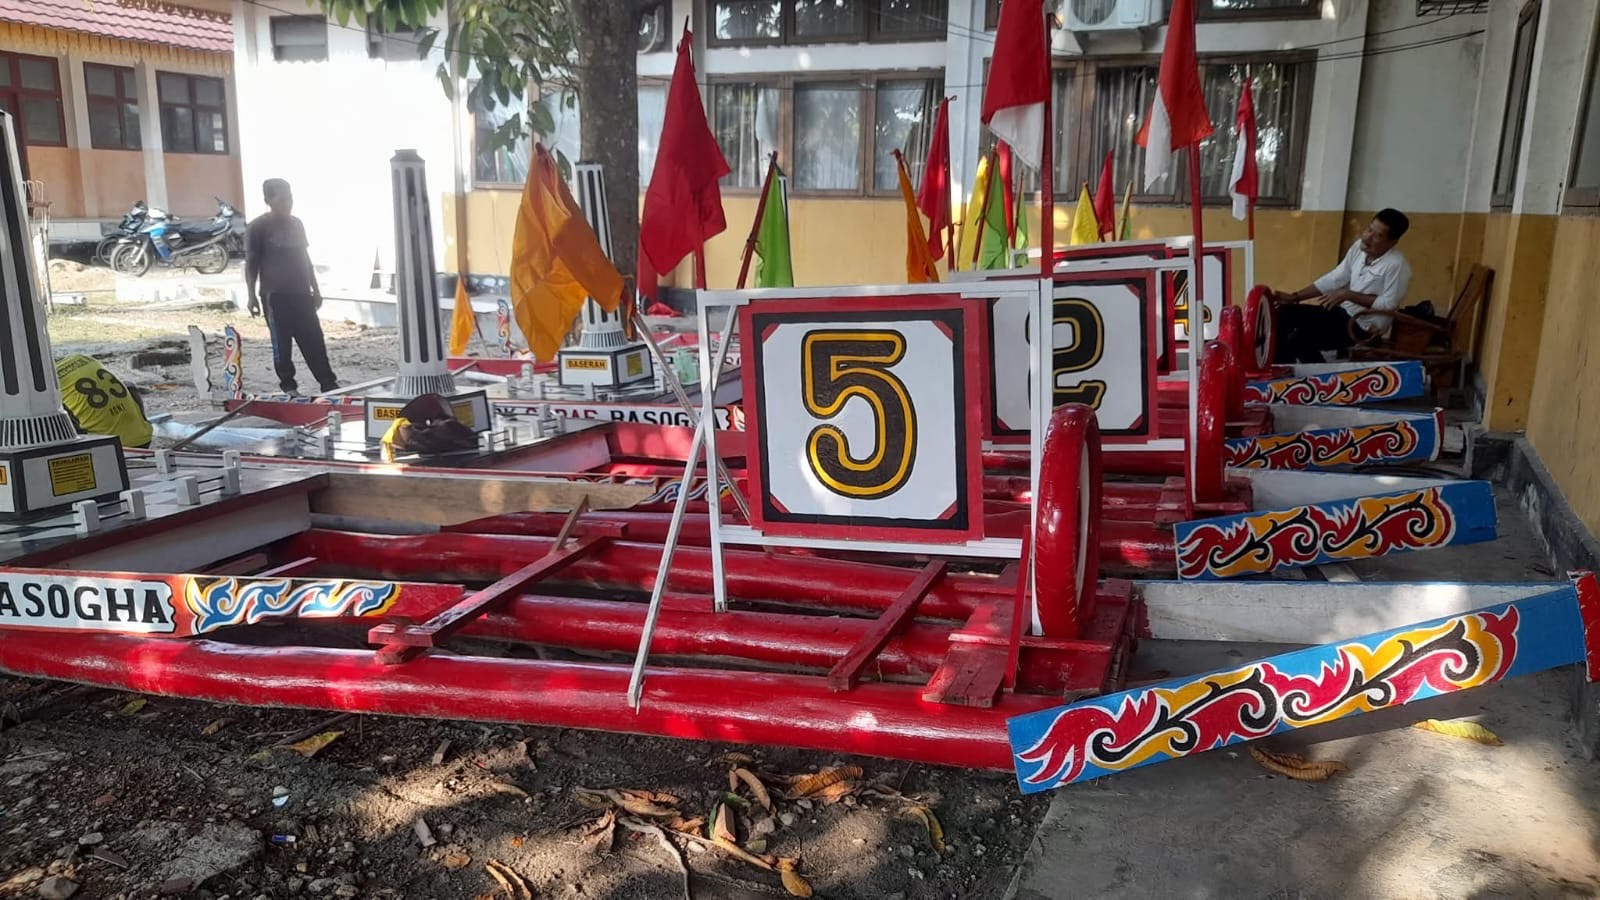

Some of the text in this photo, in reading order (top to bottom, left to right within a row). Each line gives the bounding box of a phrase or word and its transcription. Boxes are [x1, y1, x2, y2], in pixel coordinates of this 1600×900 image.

[75, 369, 127, 409] 83
[1025, 298, 1107, 411] 2
[801, 328, 918, 500] 5
